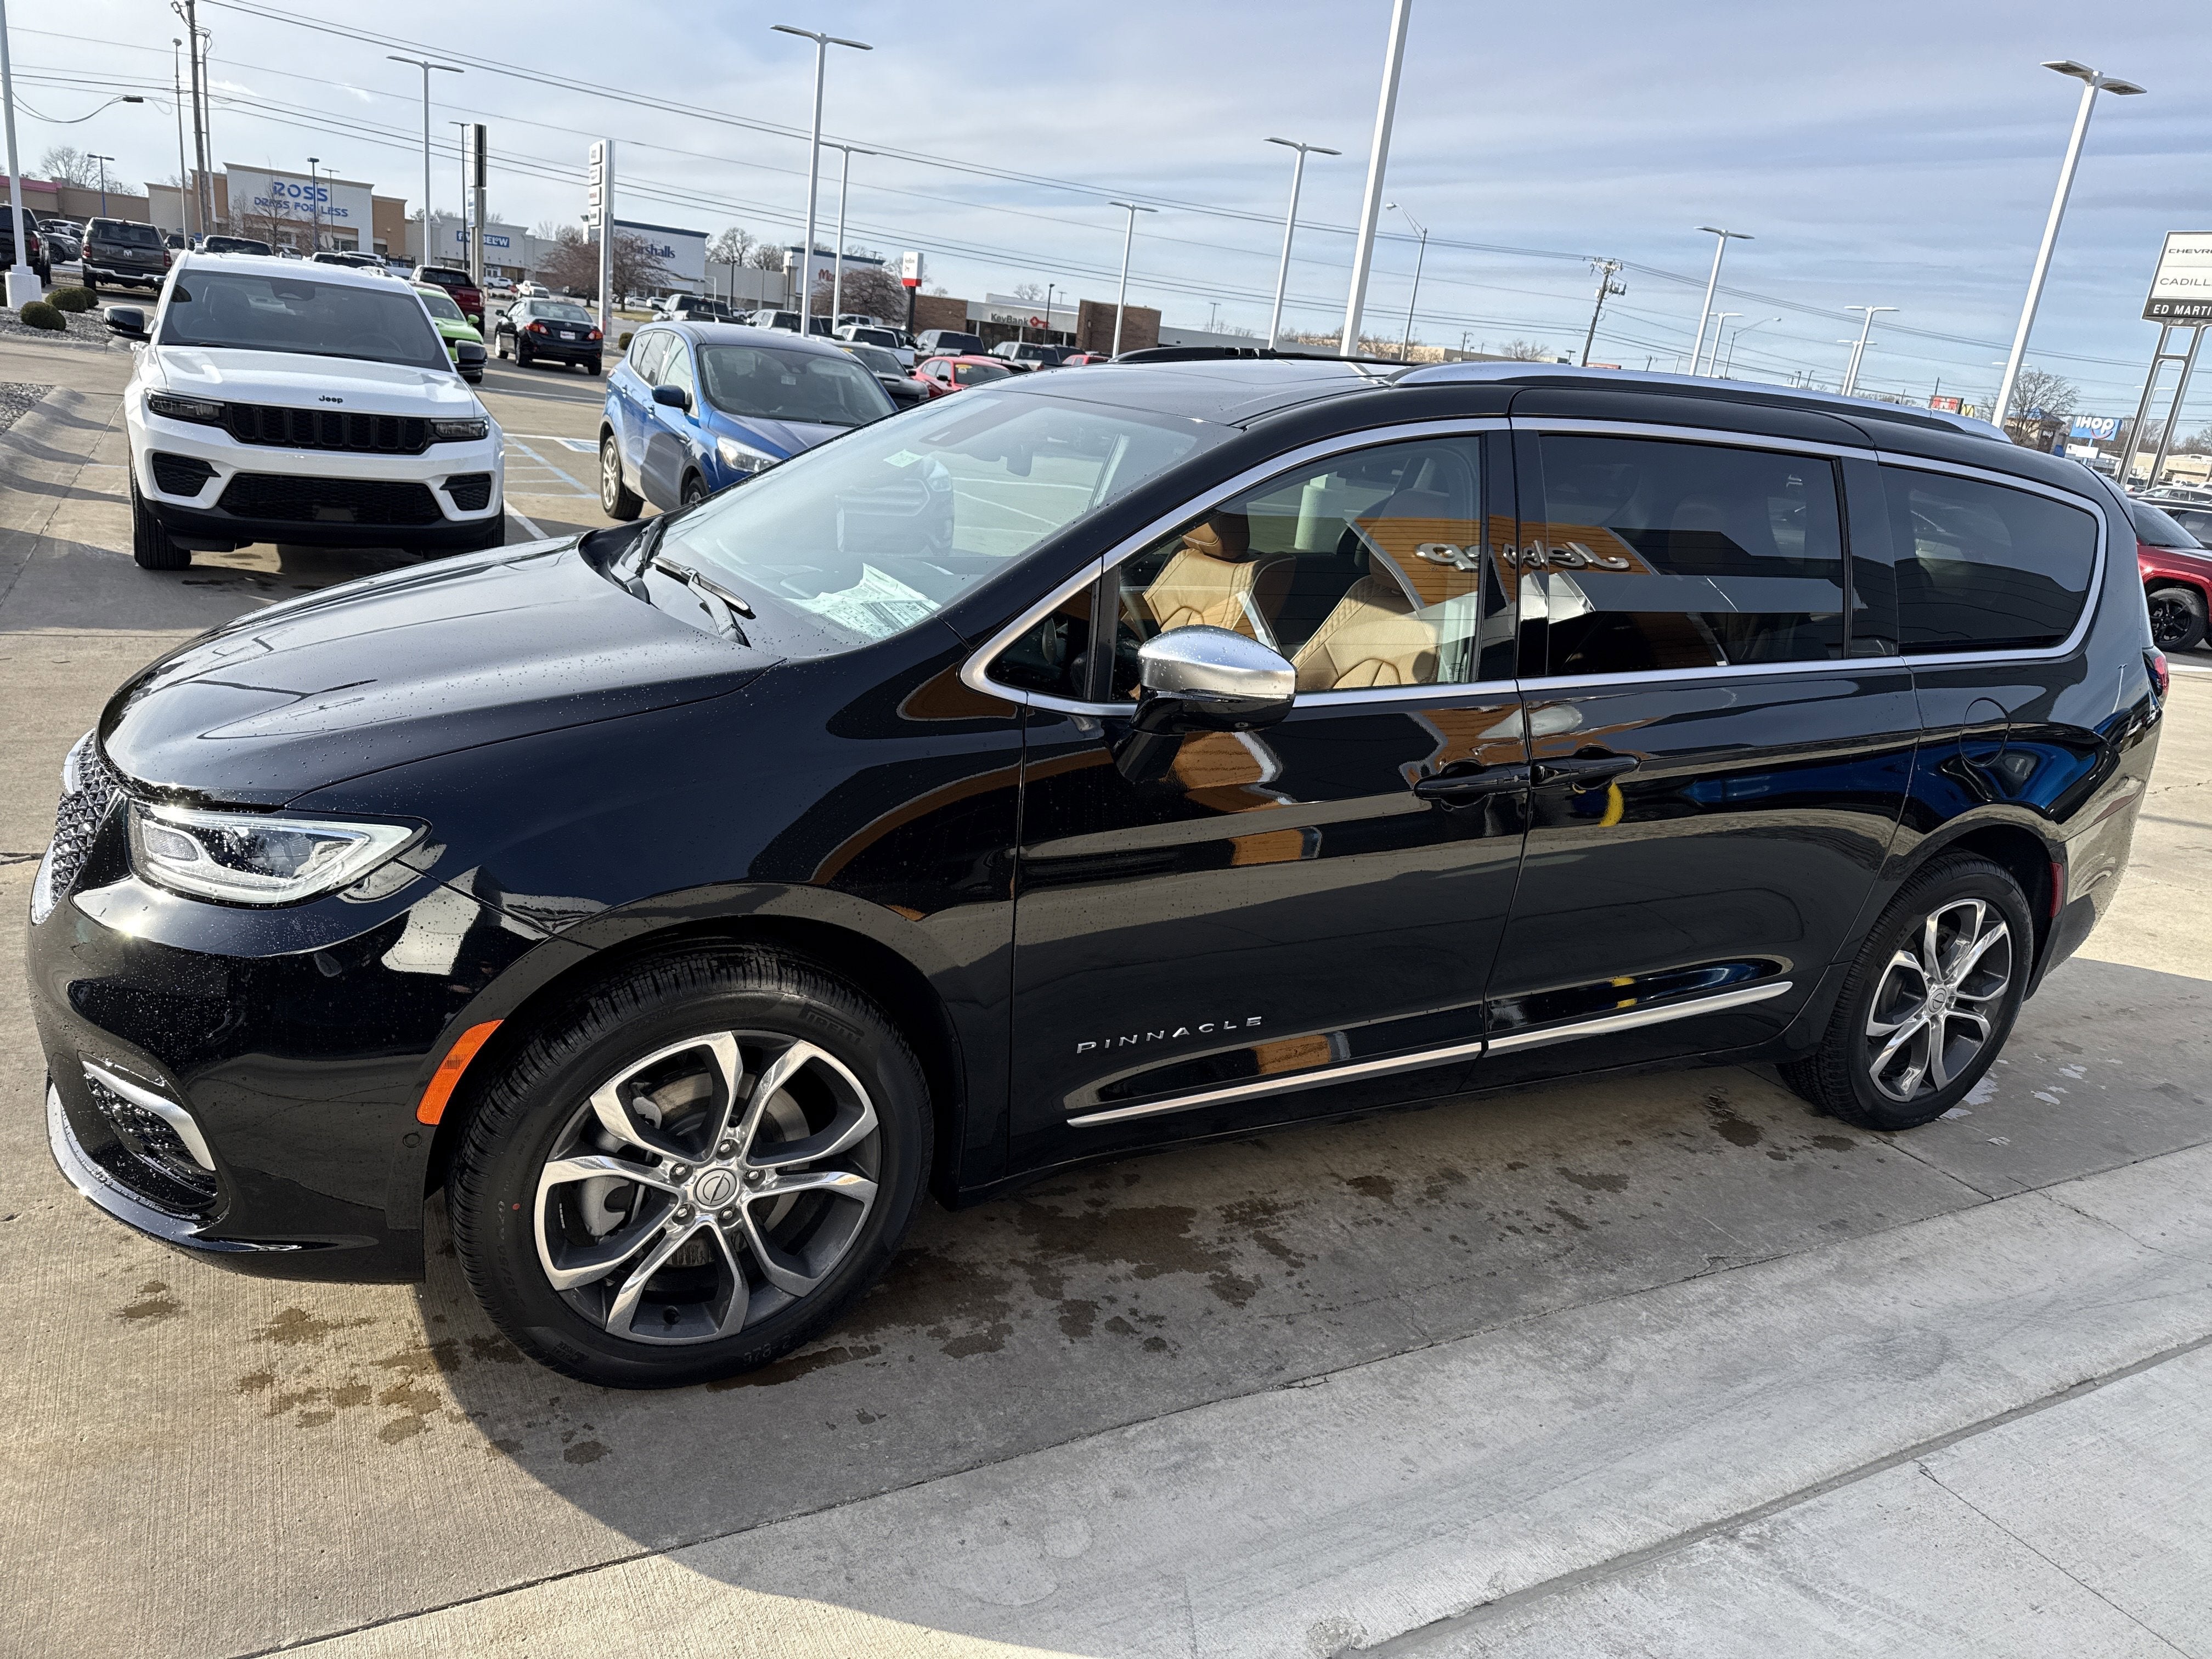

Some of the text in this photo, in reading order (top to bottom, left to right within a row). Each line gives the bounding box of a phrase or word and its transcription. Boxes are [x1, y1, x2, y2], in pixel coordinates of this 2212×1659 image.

[274, 182, 328, 202] ROSS
[321, 206, 348, 217] LESS
[2160, 278, 2212, 286] CADILL
[2153, 304, 2212, 316] ED MARTI
[991, 313, 1029, 326] KeyBank
[318, 395, 343, 404] Jeep
[798, 1003, 865, 1045] PIRELLI
[1076, 1016, 1262, 1054] PINNACLE
